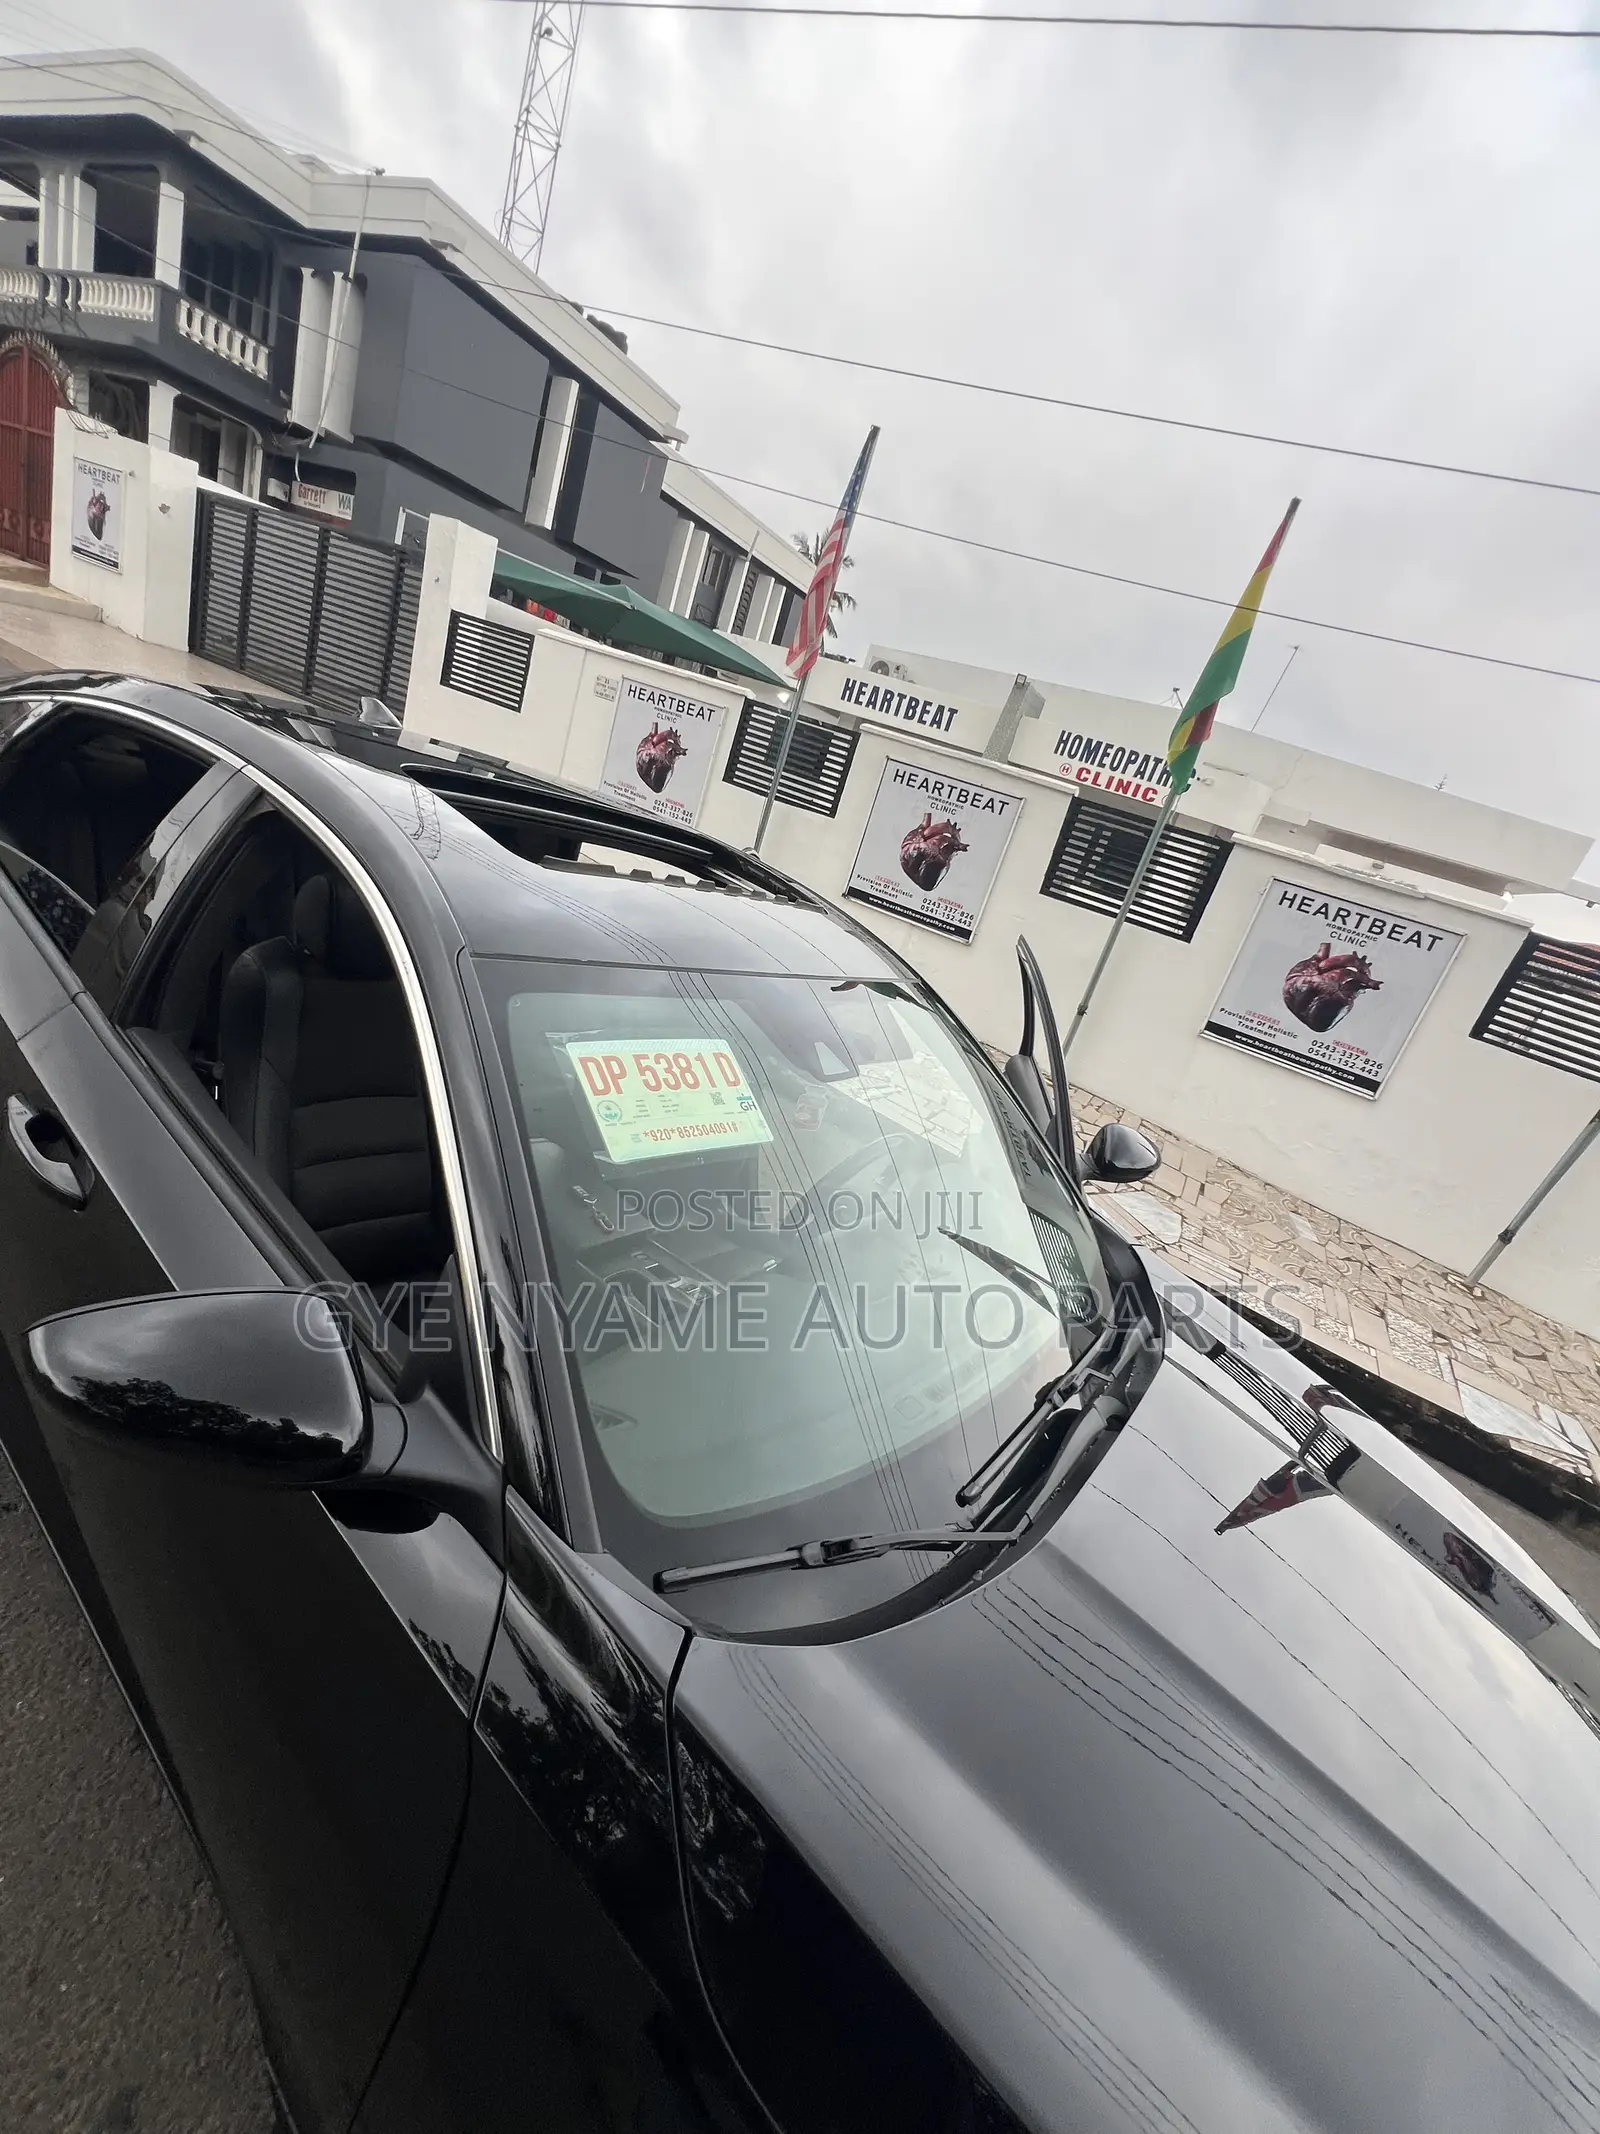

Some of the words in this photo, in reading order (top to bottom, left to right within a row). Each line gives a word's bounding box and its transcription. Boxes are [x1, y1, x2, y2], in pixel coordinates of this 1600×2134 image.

[77, 463, 121, 484] HEARTBEAT
[627, 684, 716, 722] HEARTBEAT
[840, 677, 959, 732] HEARTBEAT
[656, 712, 677, 723] CLINIC
[1053, 730, 1197, 795] HOMEOPATH
[893, 768, 1010, 816] HEARTBEAT
[1075, 767, 1158, 803] CLINIC
[927, 795, 965, 810] HOMEOPATHIC
[930, 802, 957, 816] CLINIC
[856, 874, 882, 887] Provision
[920, 904, 972, 928] 0541-152-443
[922, 897, 975, 920] 0243-337-826
[1278, 890, 1444, 952] HEARTBEAT
[1325, 922, 1378, 942] HOMEOPATHIC
[1329, 931, 1368, 948] CLINIC
[1219, 1007, 1255, 1027] Provision
[1256, 1019, 1266, 1030] Of
[1267, 1023, 1298, 1039] Holistic
[1237, 1020, 1277, 1039] Treatment
[1235, 1034, 1355, 1081] www.heartbeathomeopathy.com
[1307, 1047, 1379, 1078] 0541-152-443
[1311, 1039, 1383, 1070] 0243-337-826
[577, 1055, 628, 1097] DP
[632, 1052, 717, 1092] 5381
[712, 1052, 741, 1087] D
[739, 1101, 758, 1112] GH
